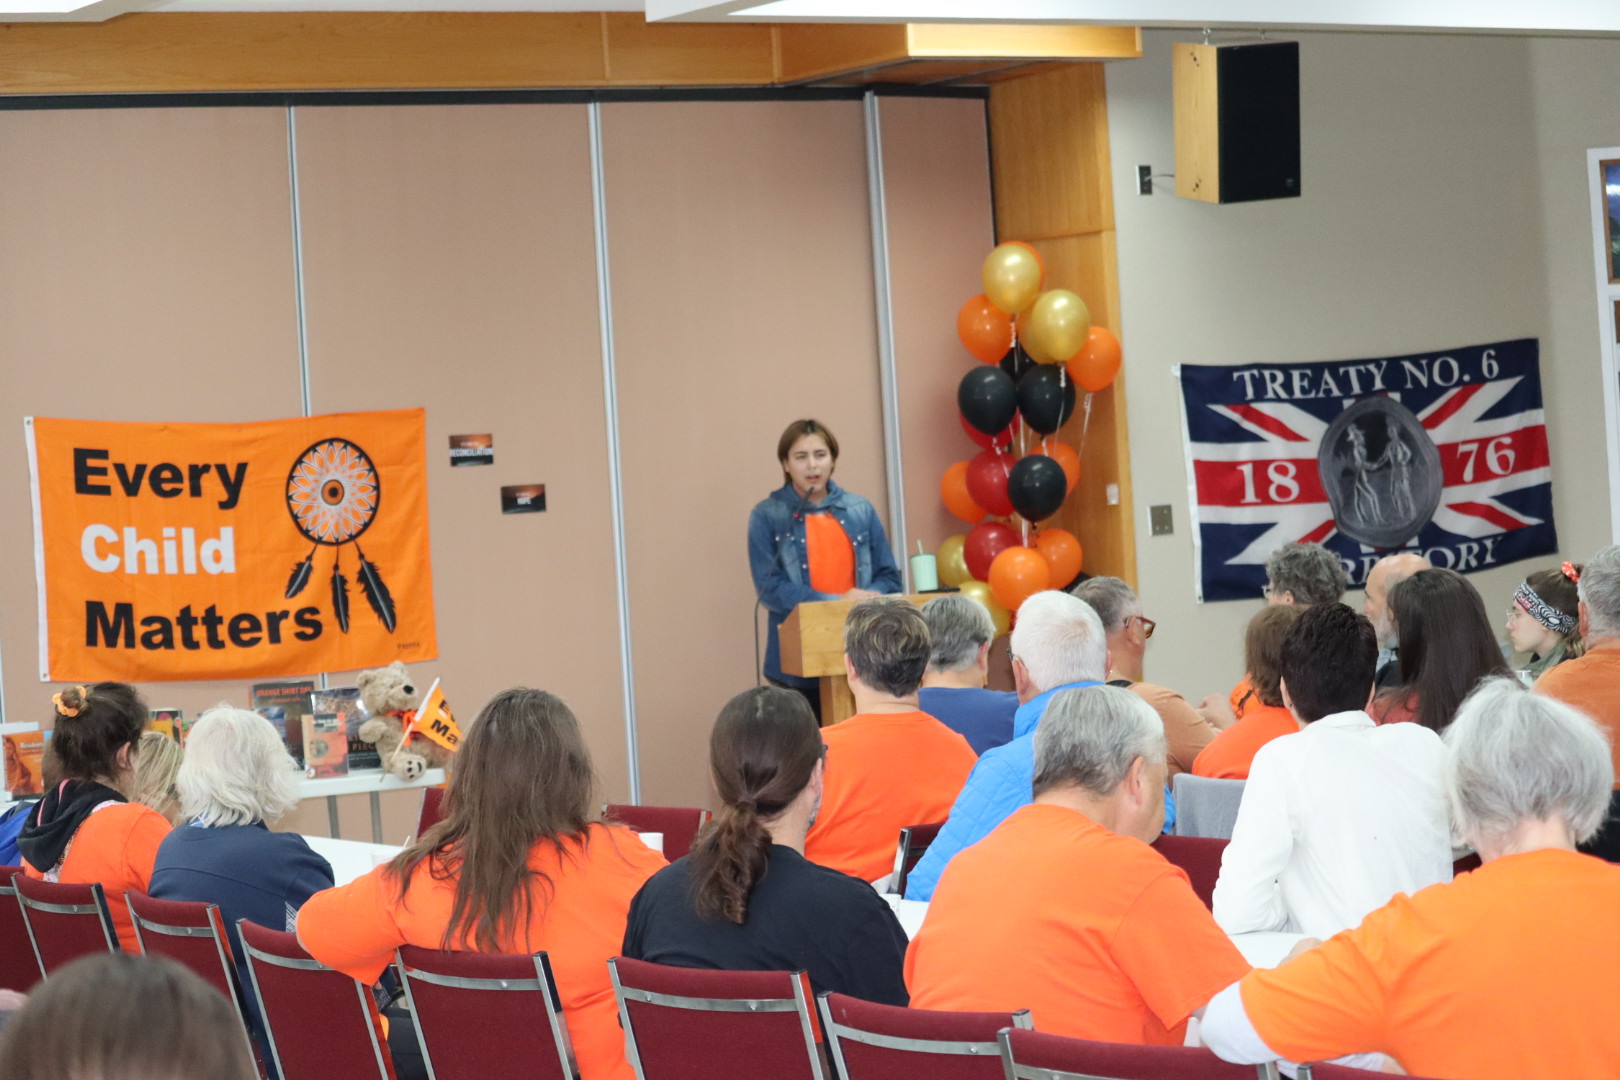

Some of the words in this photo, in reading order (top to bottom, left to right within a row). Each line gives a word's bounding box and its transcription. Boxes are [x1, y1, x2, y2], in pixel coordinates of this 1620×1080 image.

[1232, 359, 1388, 401] TREATY
[1403, 356, 1470, 390] NO.
[1481, 349, 1499, 380] 6
[73, 447, 249, 510] Every
[1236, 461, 1300, 503] 18
[1456, 437, 1516, 484] 76
[80, 523, 236, 575] Child
[85, 600, 323, 650] Matters
